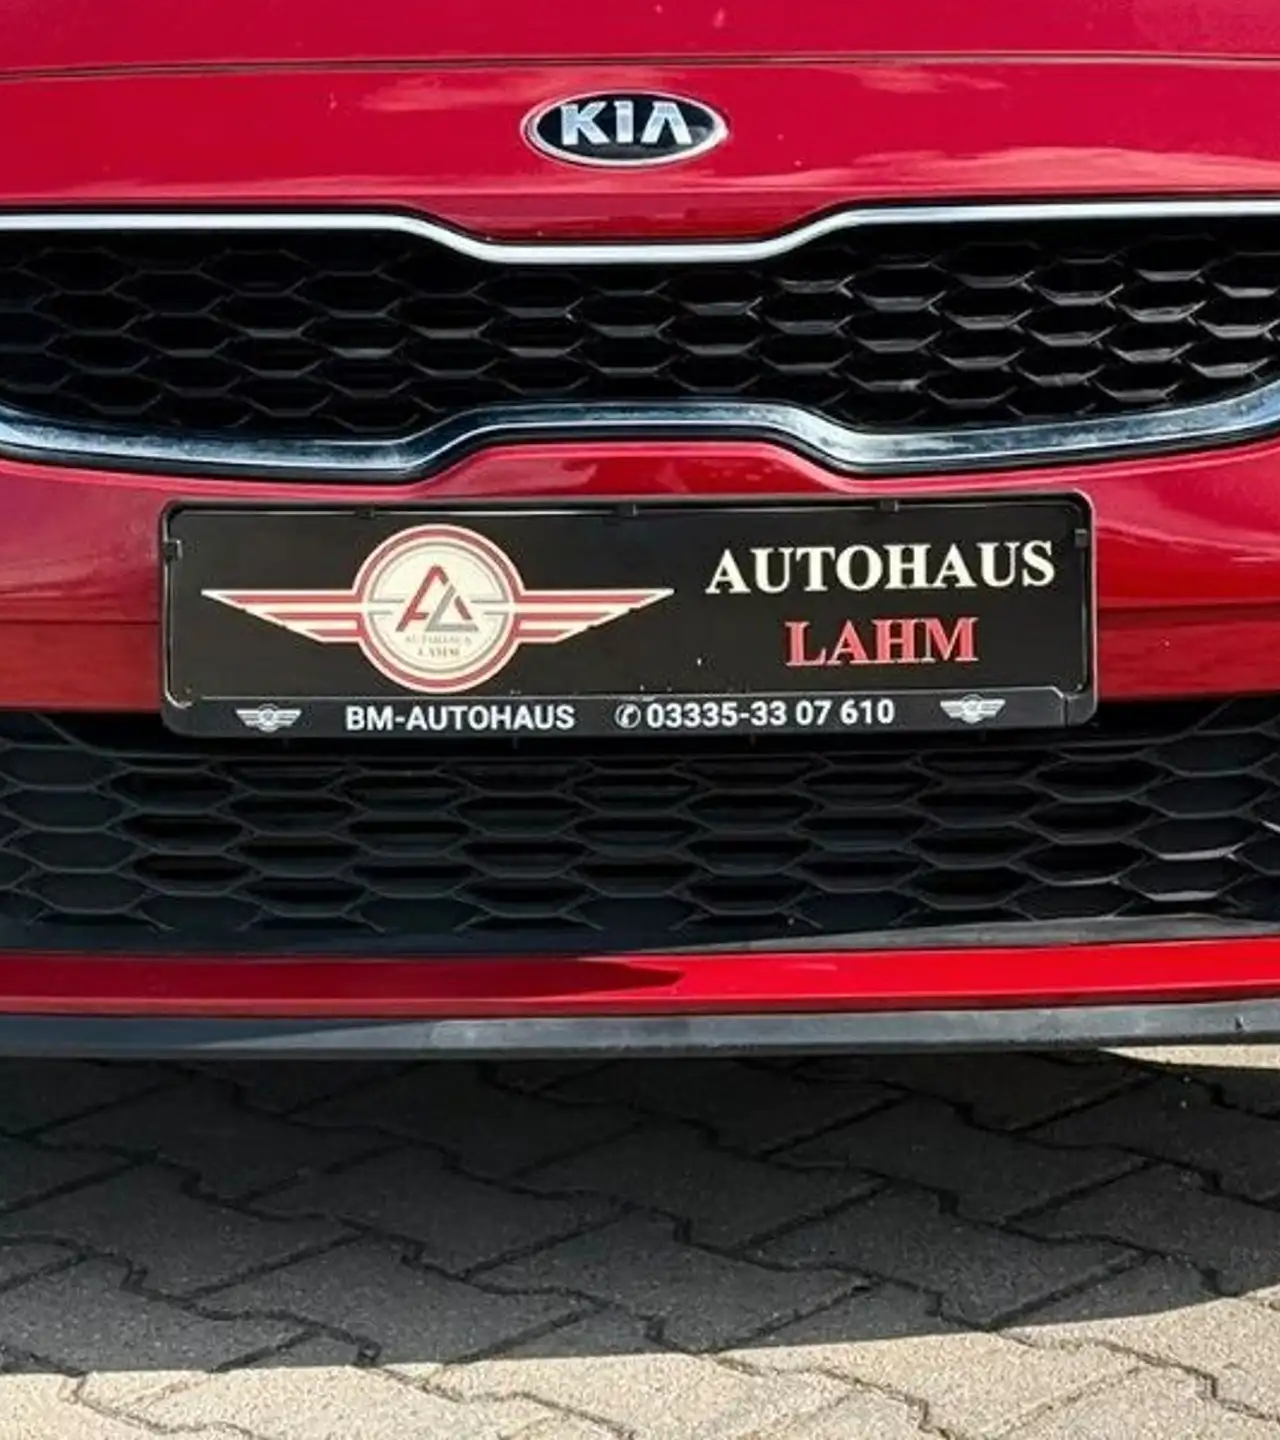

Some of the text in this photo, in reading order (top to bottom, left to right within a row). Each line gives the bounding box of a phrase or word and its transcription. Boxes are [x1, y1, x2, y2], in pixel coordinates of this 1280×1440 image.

[560, 100, 692, 146] KIA
[705, 540, 1055, 594] AUTOHAUS
[784, 617, 979, 666] LAHM
[345, 704, 575, 731] BM-AUTOHAUS
[646, 699, 895, 728] 03335-33 07 610
